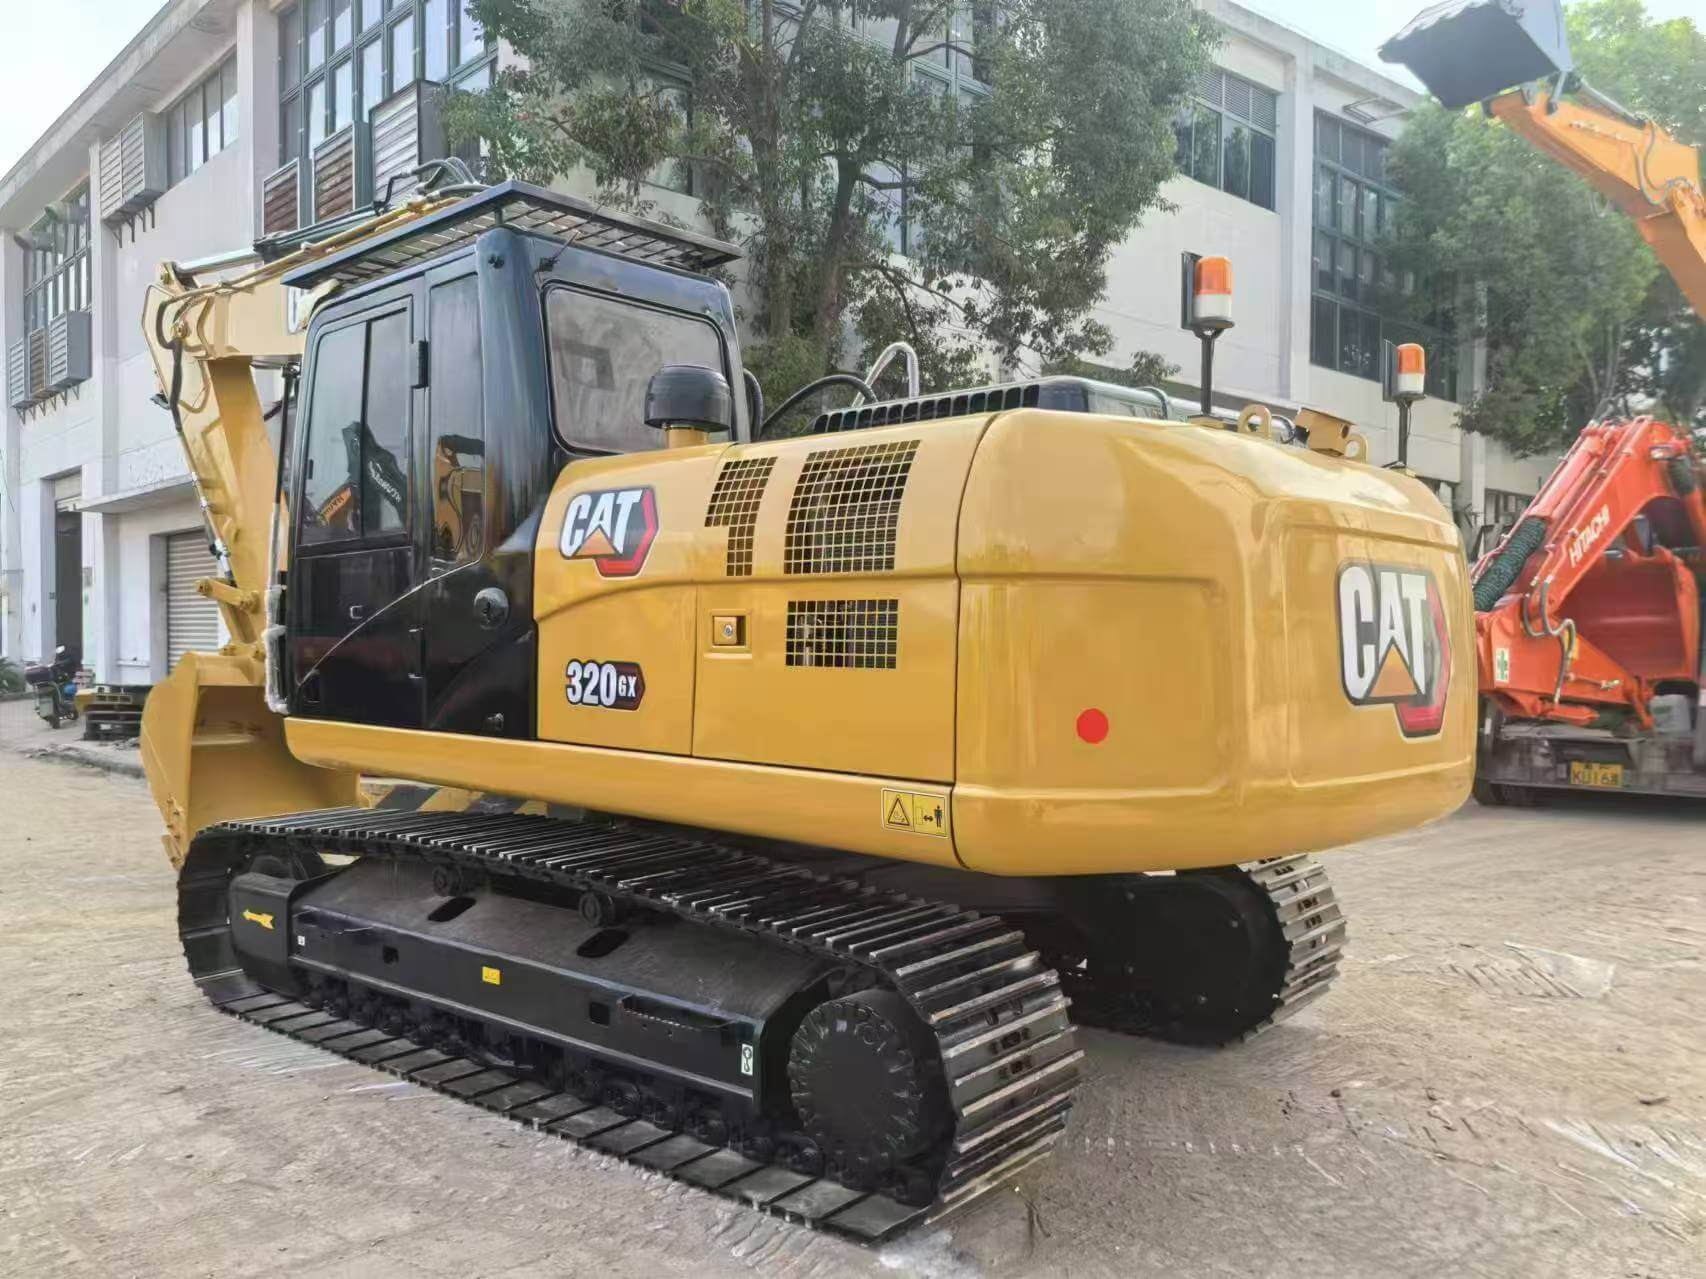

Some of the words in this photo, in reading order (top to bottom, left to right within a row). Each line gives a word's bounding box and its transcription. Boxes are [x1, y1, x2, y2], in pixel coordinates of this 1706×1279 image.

[560, 489, 643, 558] CAT
[1569, 503, 1610, 569] HITACHI
[1339, 566, 1428, 700] CAT
